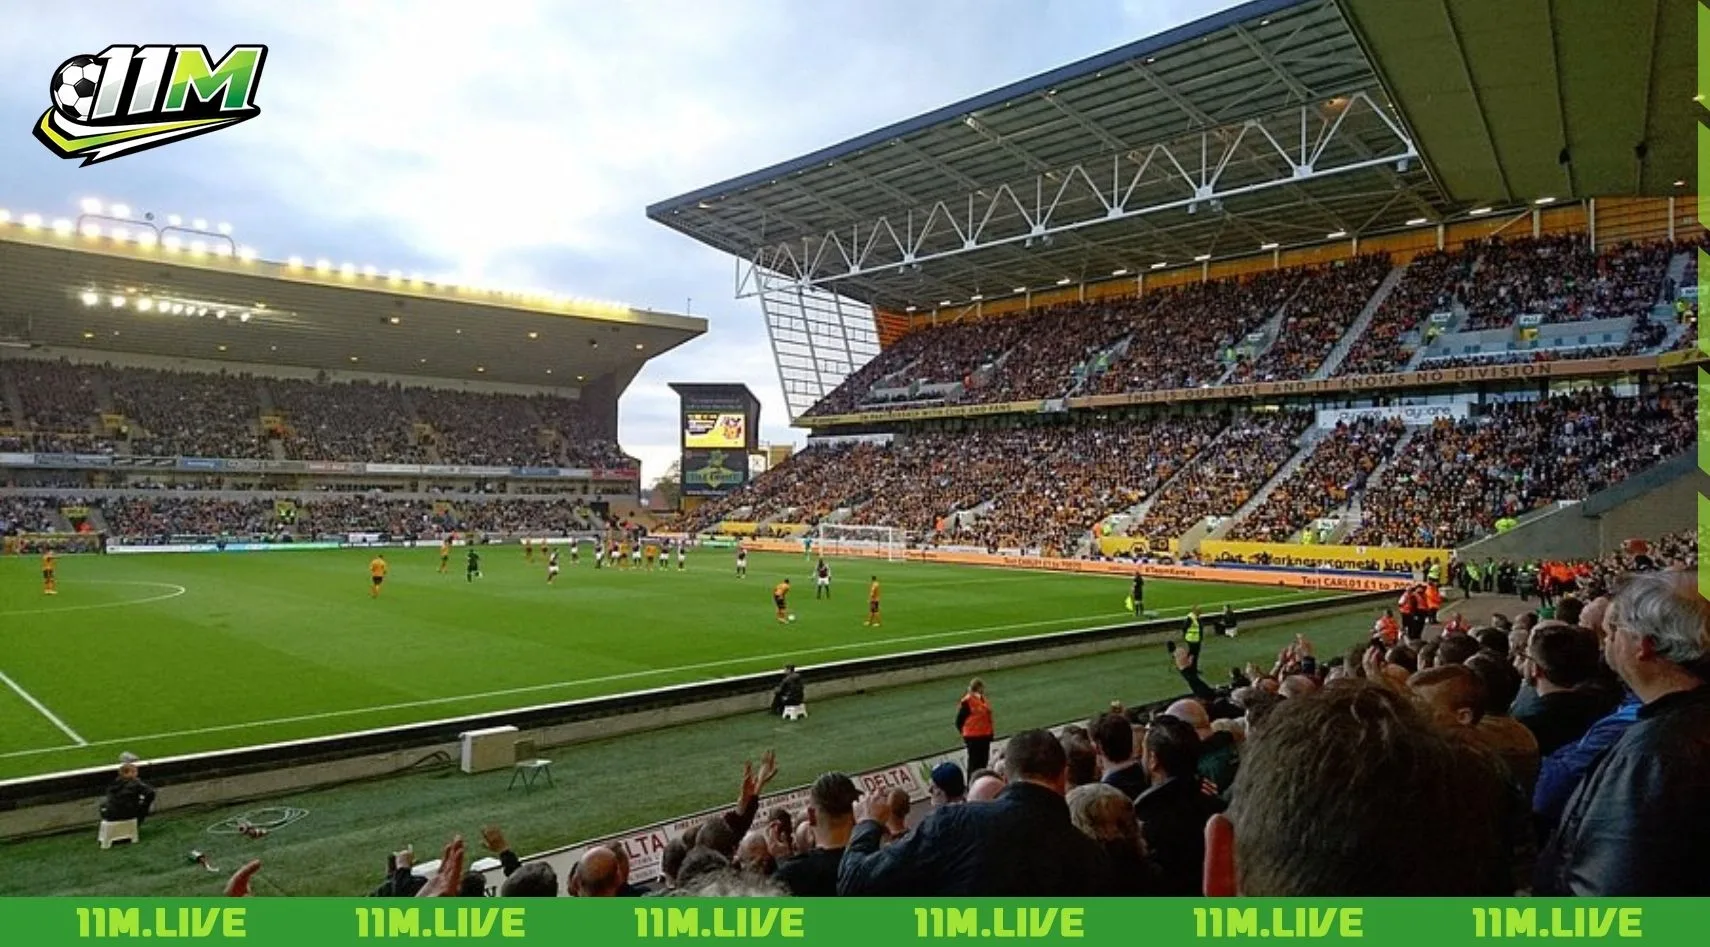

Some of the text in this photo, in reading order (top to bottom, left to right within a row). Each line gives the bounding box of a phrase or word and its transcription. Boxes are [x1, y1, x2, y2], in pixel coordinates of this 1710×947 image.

[1128, 364, 1551, 402] THIS IS OUR LOVE AND IT KNOWS NO DIVISION
[1301, 576, 1320, 586] Text
[1379, 581, 1390, 590] to
[863, 770, 911, 793] DELTA
[624, 833, 664, 859] LTA
